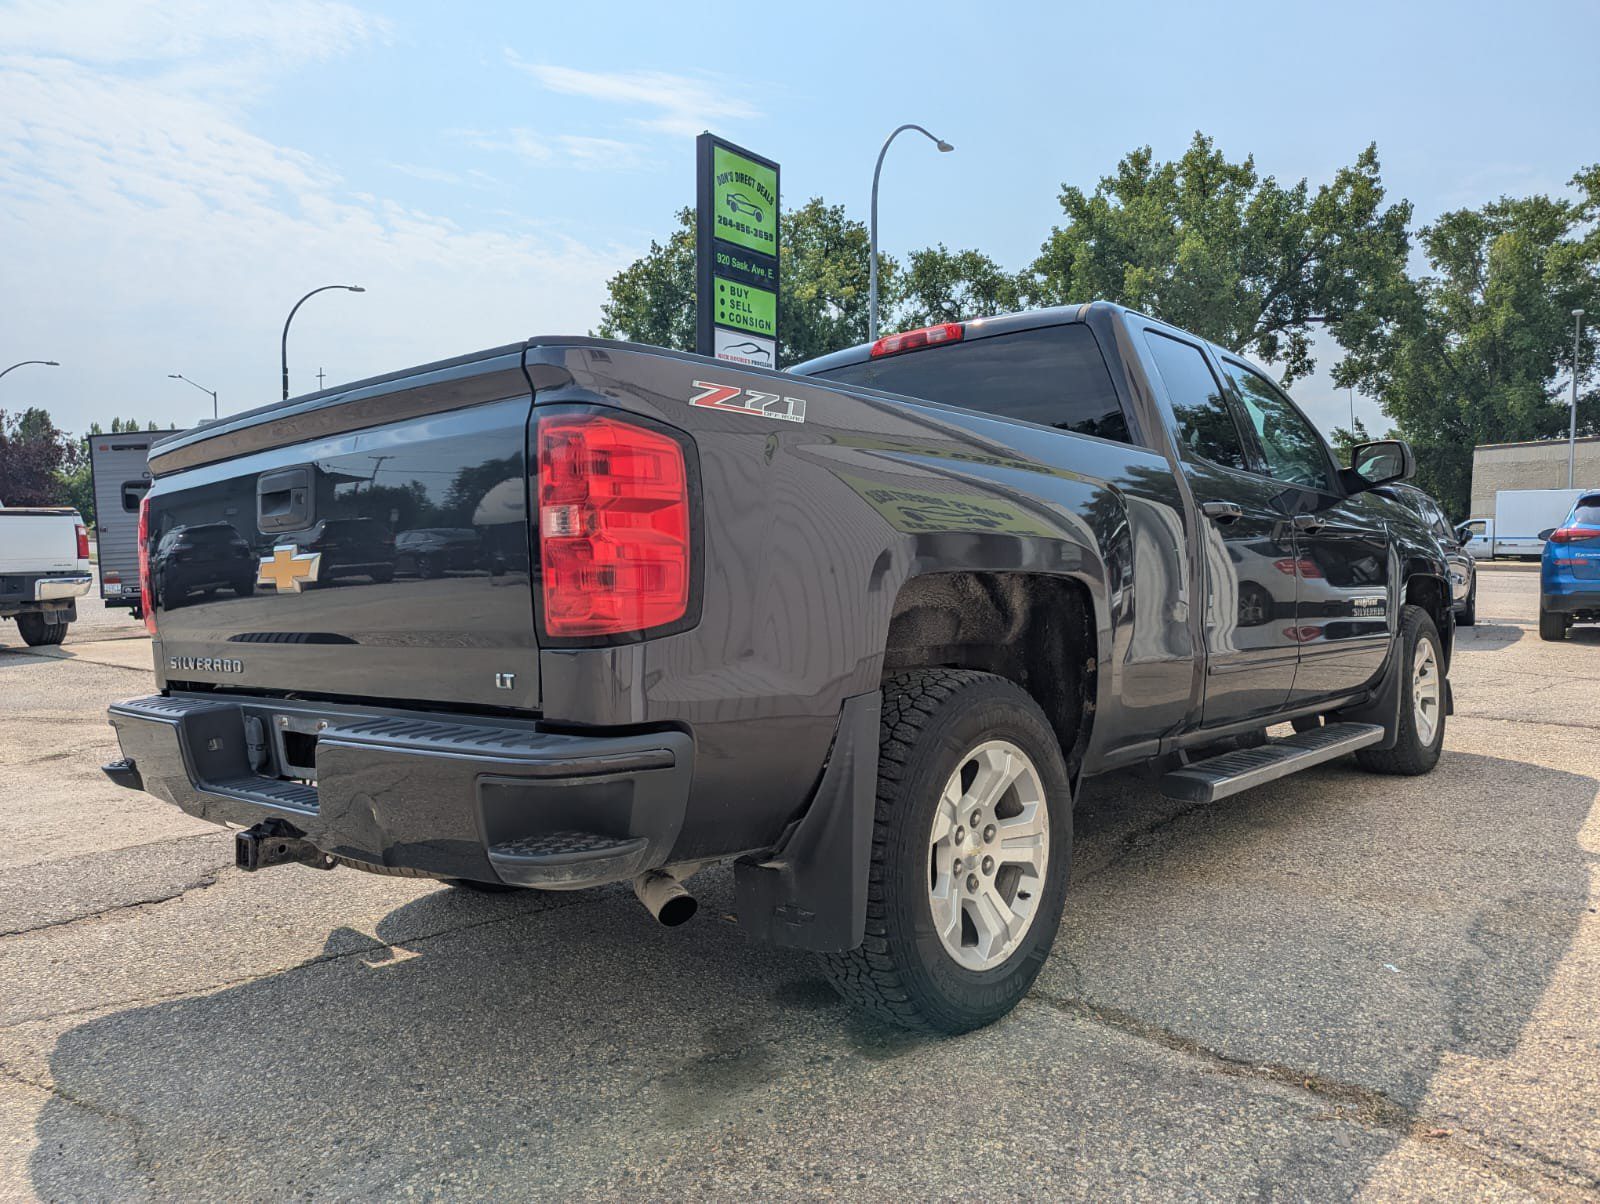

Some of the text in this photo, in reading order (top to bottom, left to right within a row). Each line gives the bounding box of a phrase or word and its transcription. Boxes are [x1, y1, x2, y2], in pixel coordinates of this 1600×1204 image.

[735, 171, 756, 189] DIRECT
[756, 182, 775, 206] DEALS
[716, 252, 730, 266] 920
[729, 286, 750, 300] BUY
[729, 299, 753, 314] SELL
[728, 312, 772, 331] CONSIGN
[688, 379, 807, 424] Z71
[170, 655, 243, 674] SILVERADO
[495, 672, 516, 690] LT
